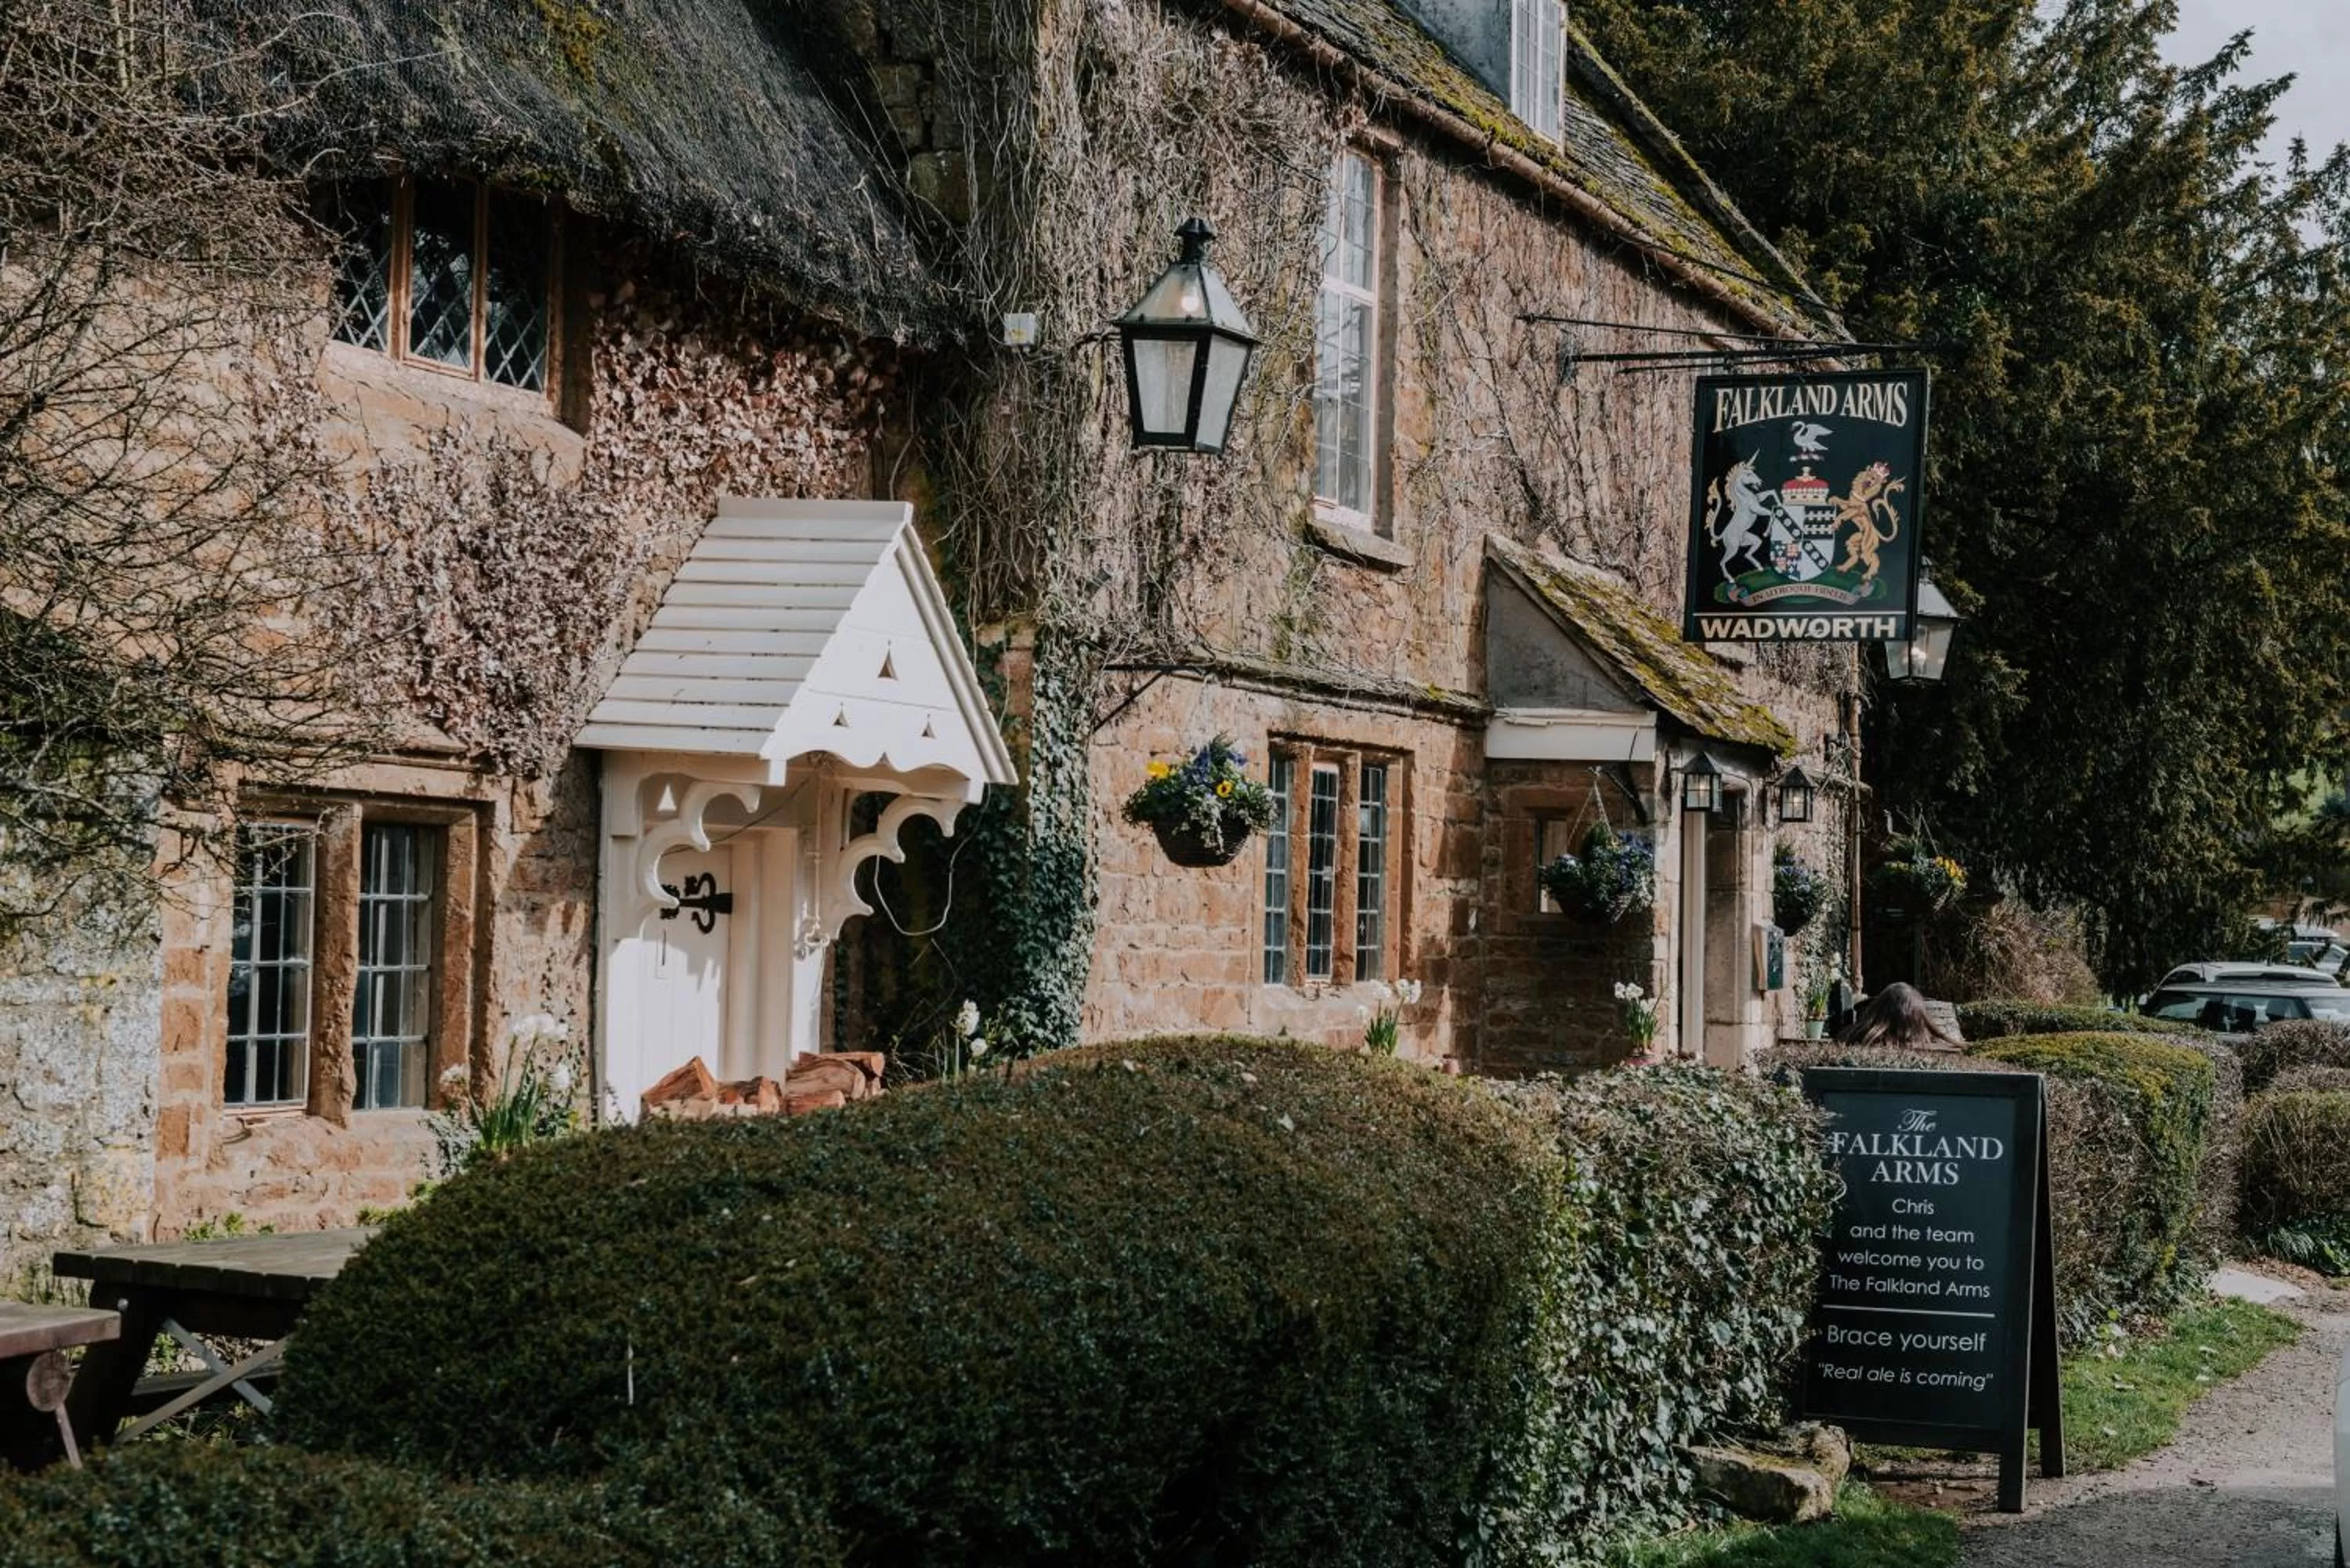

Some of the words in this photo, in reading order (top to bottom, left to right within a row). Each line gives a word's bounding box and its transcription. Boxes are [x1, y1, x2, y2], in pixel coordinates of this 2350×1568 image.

[1712, 385, 1838, 433] FALKLAND
[1840, 381, 1907, 427] ARMS
[1701, 617, 1896, 639] WADWORTH
[1897, 1108, 1937, 1132] The
[1831, 1132, 2004, 1160] FALKLAND
[1869, 1160, 1959, 1185] ARMS
[1892, 1198, 1935, 1215] Chris
[1849, 1224, 1886, 1238] and
[1892, 1225, 1921, 1241] the
[1926, 1226, 1975, 1244] team
[1838, 1250, 1922, 1267] welcome
[1926, 1255, 1961, 1271] you
[1965, 1255, 1985, 1270] to
[1829, 1274, 1860, 1291] The
[1865, 1276, 1941, 1295] Falkland
[1945, 1281, 1990, 1298] Arms
[1827, 1324, 1893, 1346] Brace
[1899, 1332, 1987, 1352] yourself
[1818, 1362, 1864, 1380] "Real
[1867, 1367, 1896, 1382] ale
[1900, 1367, 1912, 1384] is
[1916, 1371, 1994, 1392] coming"
